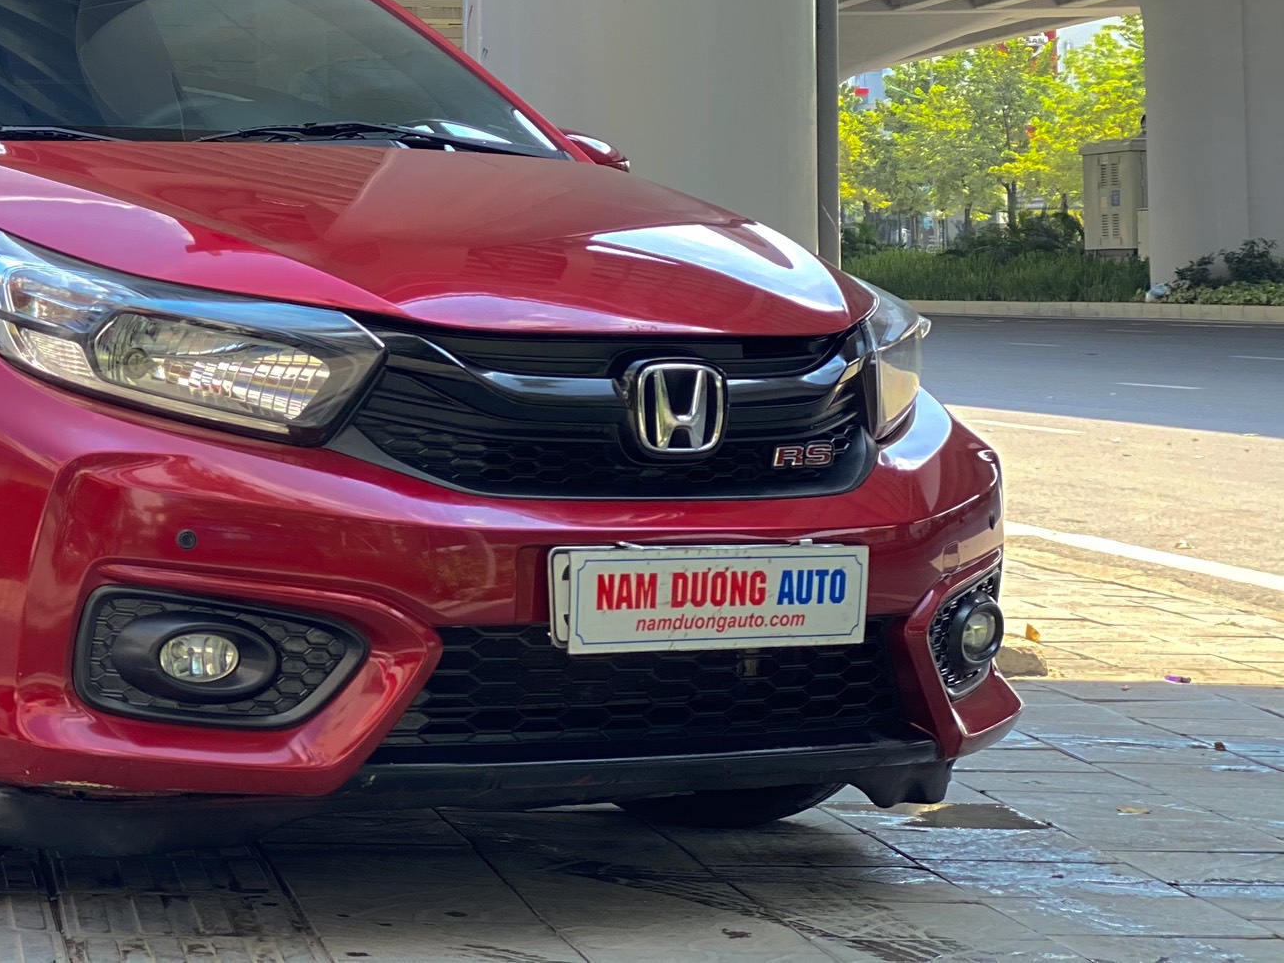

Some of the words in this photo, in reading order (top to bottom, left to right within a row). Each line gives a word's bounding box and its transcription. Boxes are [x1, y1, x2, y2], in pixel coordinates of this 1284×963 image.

[773, 443, 834, 468] RS
[596, 573, 658, 610] NAM
[671, 566, 766, 609] DƯƠNG
[777, 569, 846, 605] AUTO
[636, 613, 805, 633] namduongauto.com
